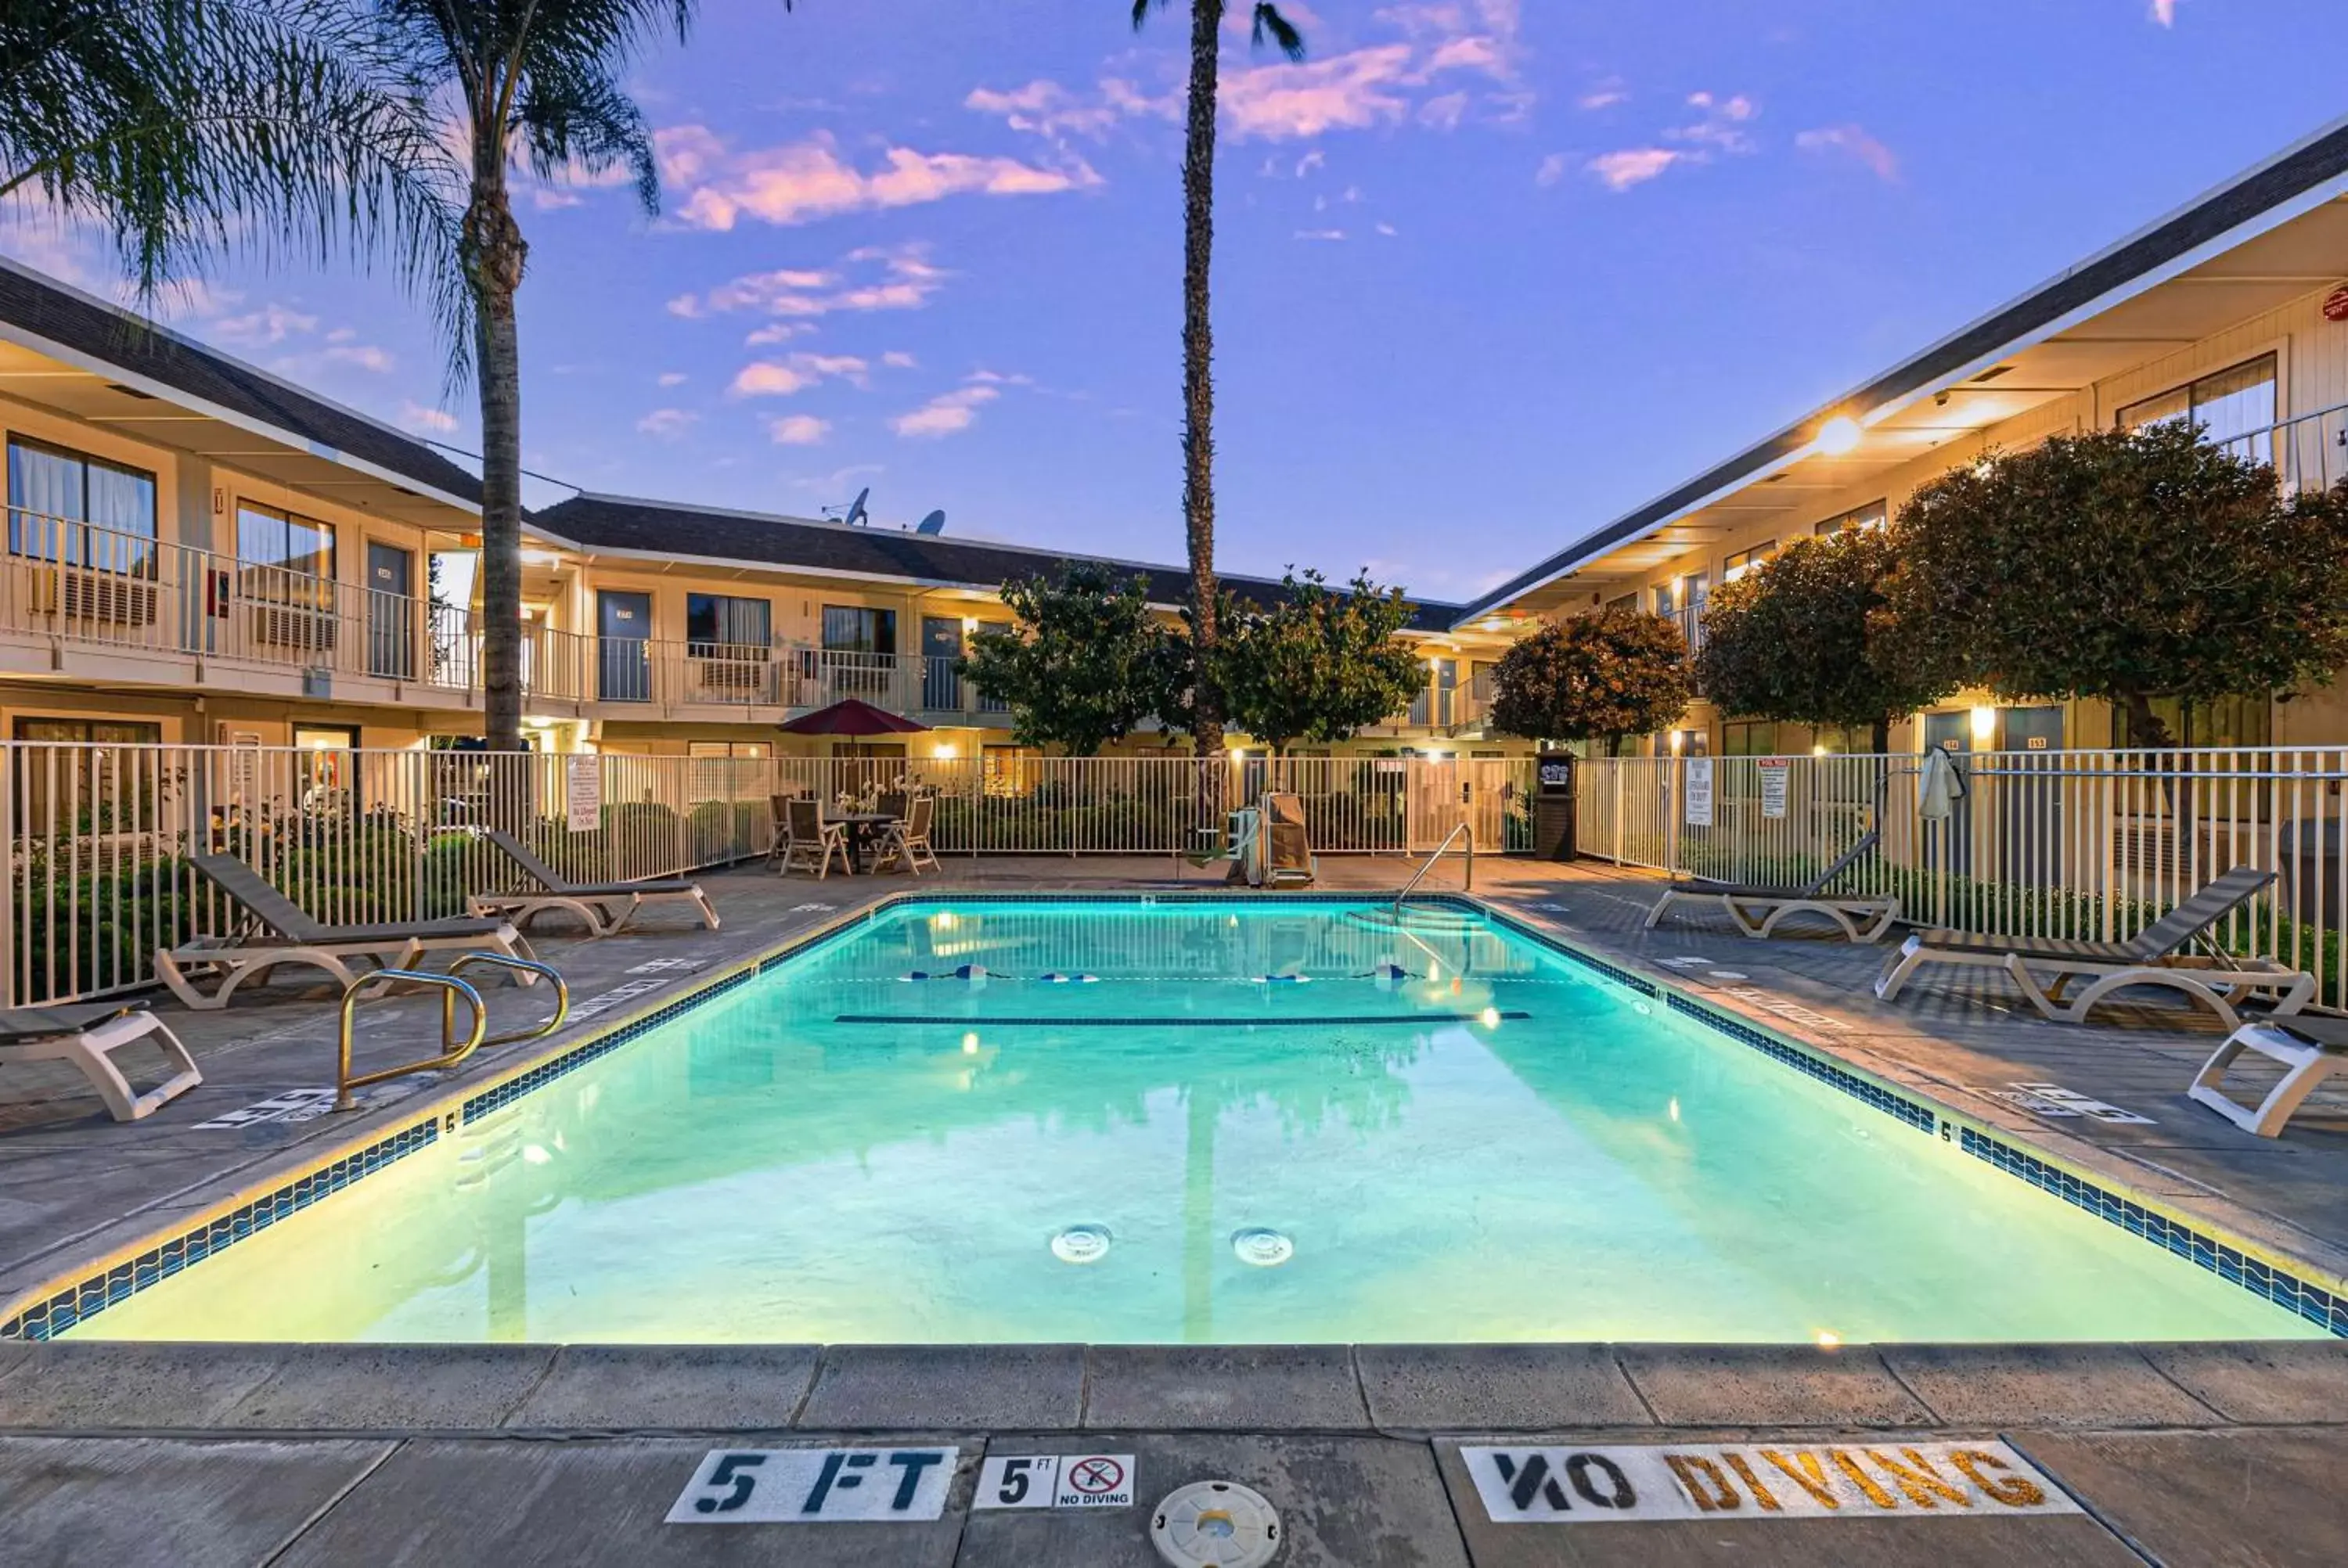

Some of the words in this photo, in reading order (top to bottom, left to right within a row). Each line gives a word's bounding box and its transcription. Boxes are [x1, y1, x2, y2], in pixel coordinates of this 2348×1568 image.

[446, 1112, 455, 1133] 5
[1942, 1120, 1951, 1142] 5
[695, 1455, 767, 1513] 5
[801, 1453, 944, 1513] FT
[999, 1459, 1032, 1504] 5
[1037, 1458, 1052, 1470] FT
[1493, 1454, 1637, 1511] NO
[1663, 1448, 2045, 1511] DIVING
[1060, 1494, 1079, 1505] NO
[1083, 1494, 1129, 1504] DIVING
